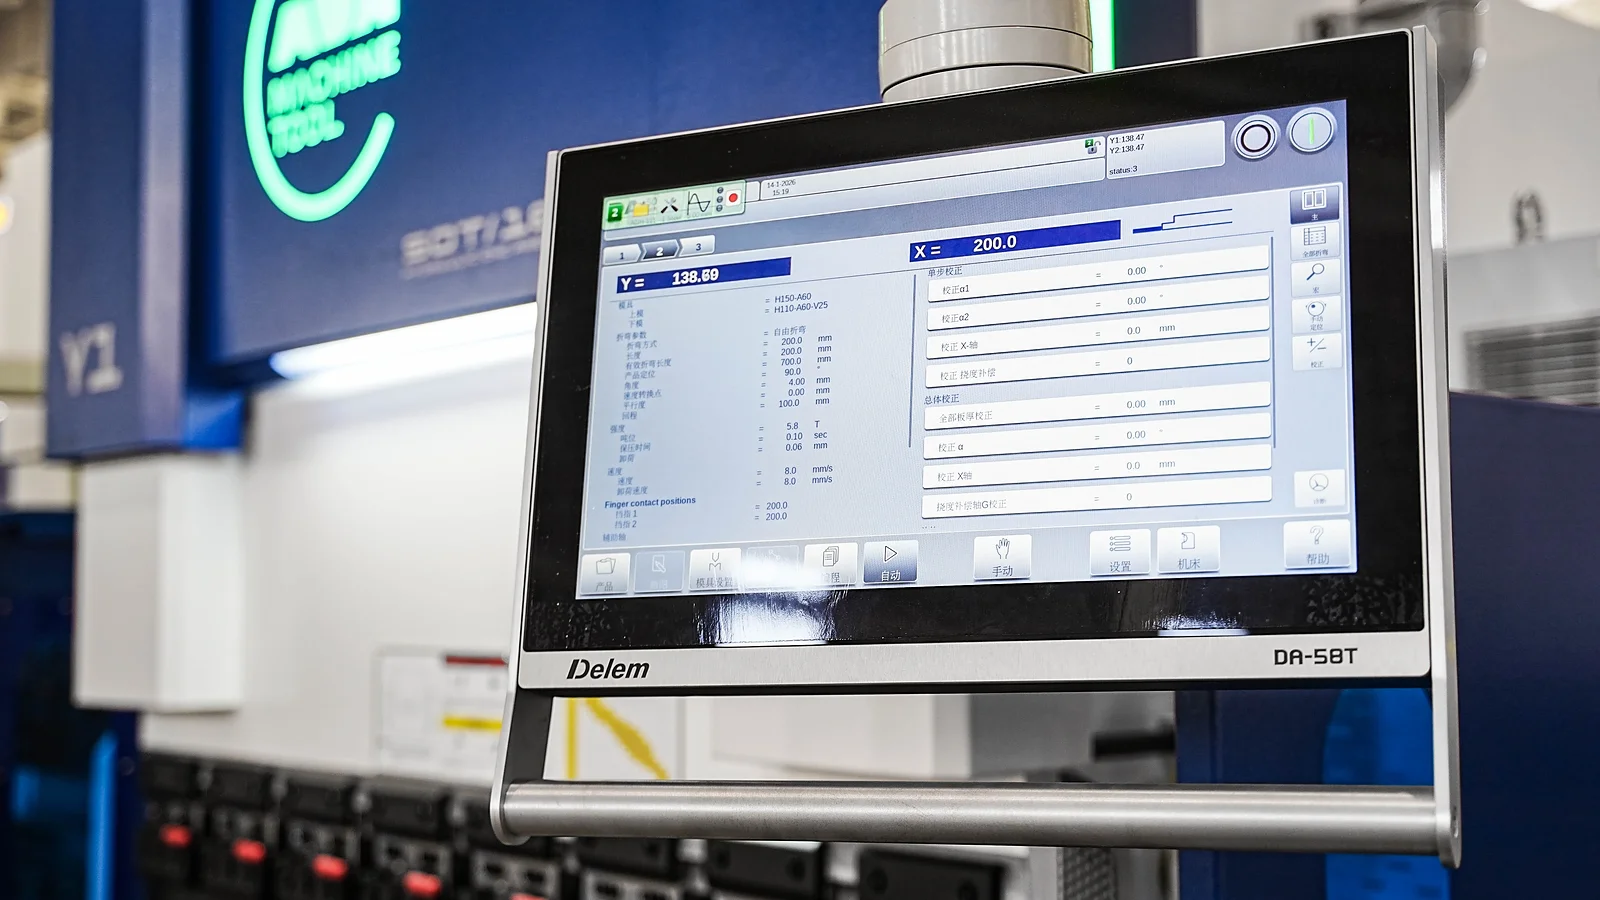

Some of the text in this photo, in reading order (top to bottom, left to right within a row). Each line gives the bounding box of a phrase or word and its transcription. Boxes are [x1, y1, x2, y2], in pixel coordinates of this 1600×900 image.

[267, 30, 401, 118] MACHINE
[267, 99, 345, 158] TOOL
[1109, 134, 1145, 144] Y1:138.47
[1109, 144, 1145, 154] Y2:138.47
[1109, 165, 1138, 175] status:3
[656, 248, 664, 256] 2
[696, 243, 702, 251] 3
[914, 245, 926, 258] X
[973, 235, 1017, 252] 200.0
[928, 266, 963, 278] 单步校正
[1127, 266, 1147, 276] 0.00
[621, 278, 632, 291] Y
[775, 293, 812, 303] H150-A60
[1127, 296, 1147, 306] 0.00
[774, 302, 828, 314] H110-A60-V25
[1127, 326, 1141, 336] 0.0
[1159, 324, 1176, 332] mm
[781, 337, 802, 346] 200.0
[781, 347, 802, 356] 200.0
[817, 345, 832, 353] mm
[60, 321, 123, 396] Y1
[781, 358, 802, 366] 700.0
[784, 368, 801, 376] 90.0
[789, 378, 806, 386] 4.00
[816, 376, 831, 384] mm
[788, 388, 805, 396] 0.00
[779, 399, 800, 408] 100.0
[816, 397, 830, 405] mm
[924, 394, 960, 405] 总体校正
[1126, 400, 1146, 410] 0.00
[1159, 398, 1176, 406] mm
[786, 422, 799, 430] 5.8
[786, 432, 803, 441] 0.10
[814, 431, 828, 439] sec
[1126, 430, 1146, 440] 0.00
[786, 443, 803, 452] 0.06
[813, 442, 828, 450] mm
[785, 467, 797, 475] 8.0
[812, 465, 833, 474] mm/s
[1126, 461, 1141, 470] 0.0
[1159, 460, 1176, 468] mm
[784, 477, 796, 486] 8.0
[812, 475, 833, 484] mm/s
[605, 497, 696, 510] Finger contact positions
[766, 502, 788, 510] 200.0
[766, 512, 788, 521] 200.0
[1178, 558, 1201, 570] 机床
[1306, 552, 1330, 566] 帮助
[992, 565, 1014, 577] 手动
[1109, 561, 1132, 573] 设置
[881, 570, 900, 582] 自动
[1274, 648, 1358, 665] DA-58T
[566, 659, 650, 679] Delem
